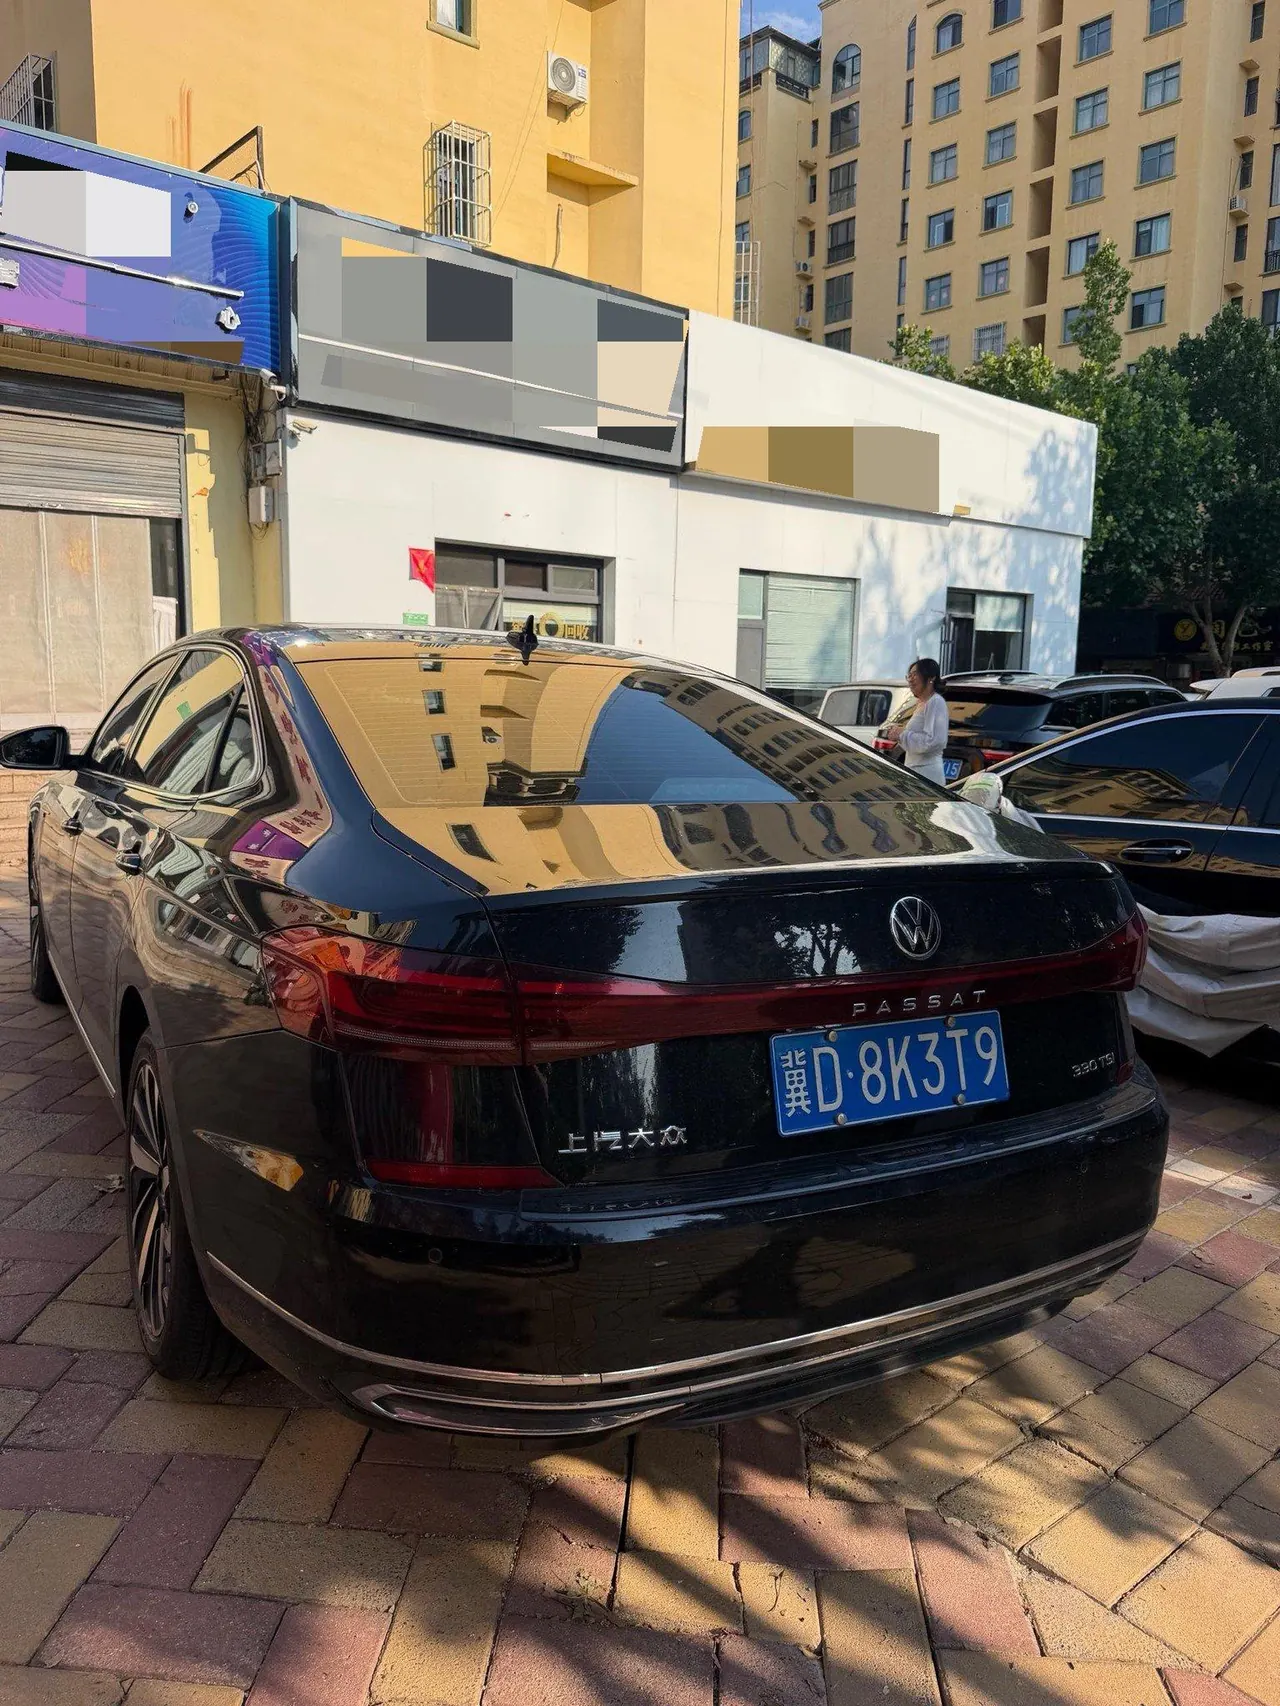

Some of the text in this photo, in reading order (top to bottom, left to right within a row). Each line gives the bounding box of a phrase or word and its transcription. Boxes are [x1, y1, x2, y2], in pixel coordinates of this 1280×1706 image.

[852, 989, 986, 1017] PASSAT
[558, 1125, 687, 1153] 上汽大众
